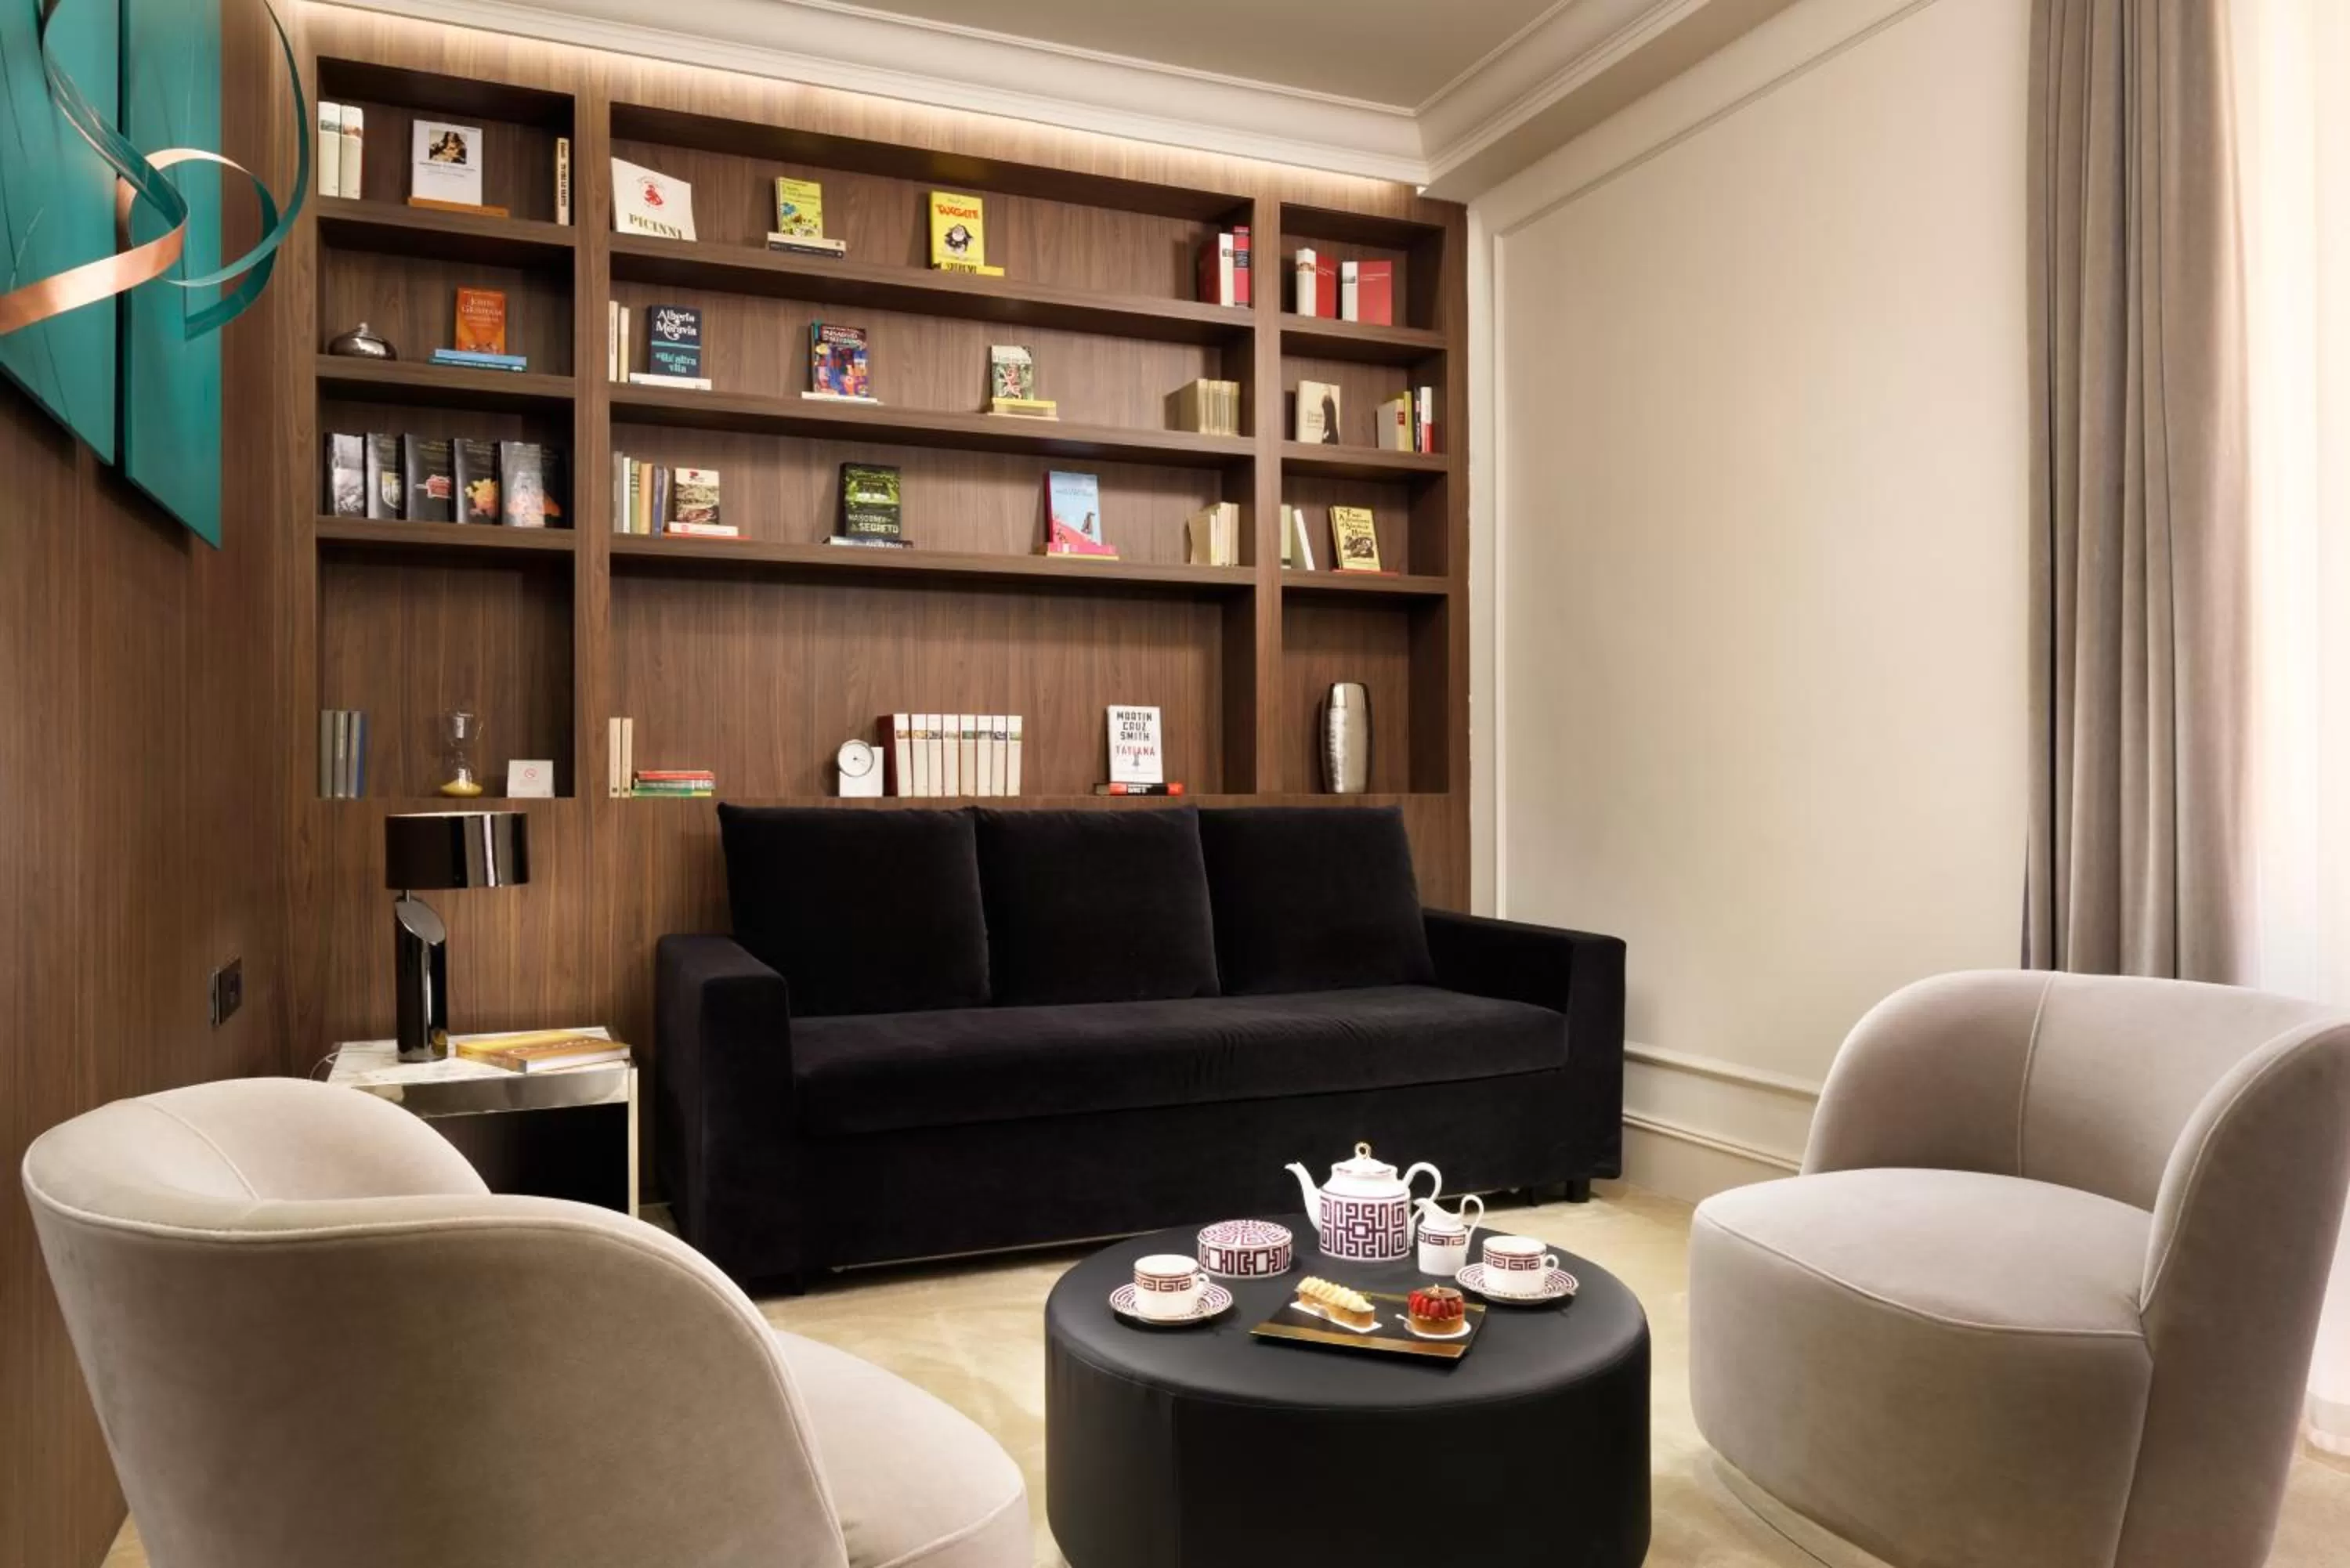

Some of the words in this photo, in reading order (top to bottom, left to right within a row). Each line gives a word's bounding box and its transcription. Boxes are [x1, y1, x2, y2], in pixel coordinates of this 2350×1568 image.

[1116, 711, 1153, 721] MARTIN
[1123, 721, 1147, 731] CRUZ
[1120, 731, 1150, 742] SMITH
[1115, 746, 1155, 757] TATIANA
